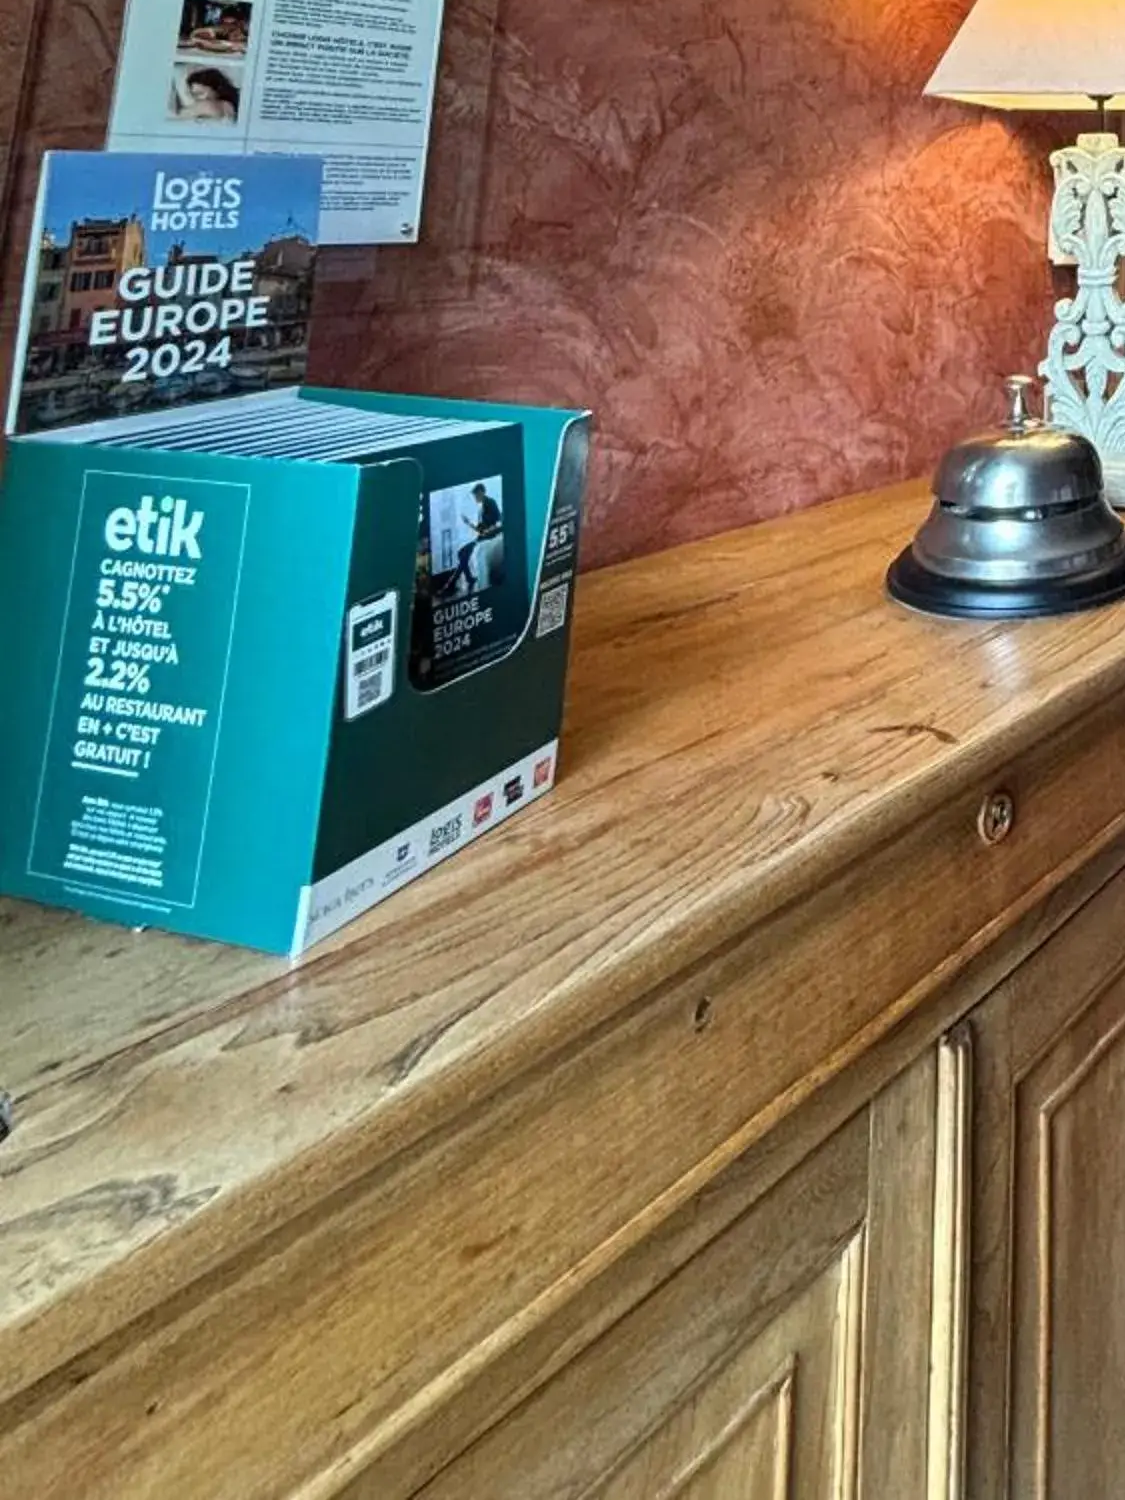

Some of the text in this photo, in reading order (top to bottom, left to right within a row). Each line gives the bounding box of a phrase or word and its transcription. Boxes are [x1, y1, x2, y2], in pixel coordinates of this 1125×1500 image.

[151, 210, 239, 232] HOTELS
[118, 260, 257, 302] GUIDE
[89, 296, 271, 346] EUROPE
[122, 336, 233, 384] 2024
[104, 495, 205, 559] etik
[101, 558, 197, 585] CAGNOTTEZ
[91, 609, 172, 640] À L'HÔTEL
[432, 596, 481, 626] GUIDE
[432, 607, 494, 644] EUROPE
[88, 636, 180, 665] ET JUSQU'À
[433, 635, 472, 660] 2024
[84, 657, 150, 694] 2.2%
[80, 693, 208, 728] AU RESTAURANT
[77, 716, 101, 736] EN
[115, 722, 162, 746] C'EST
[73, 740, 142, 768] GRATUIT
